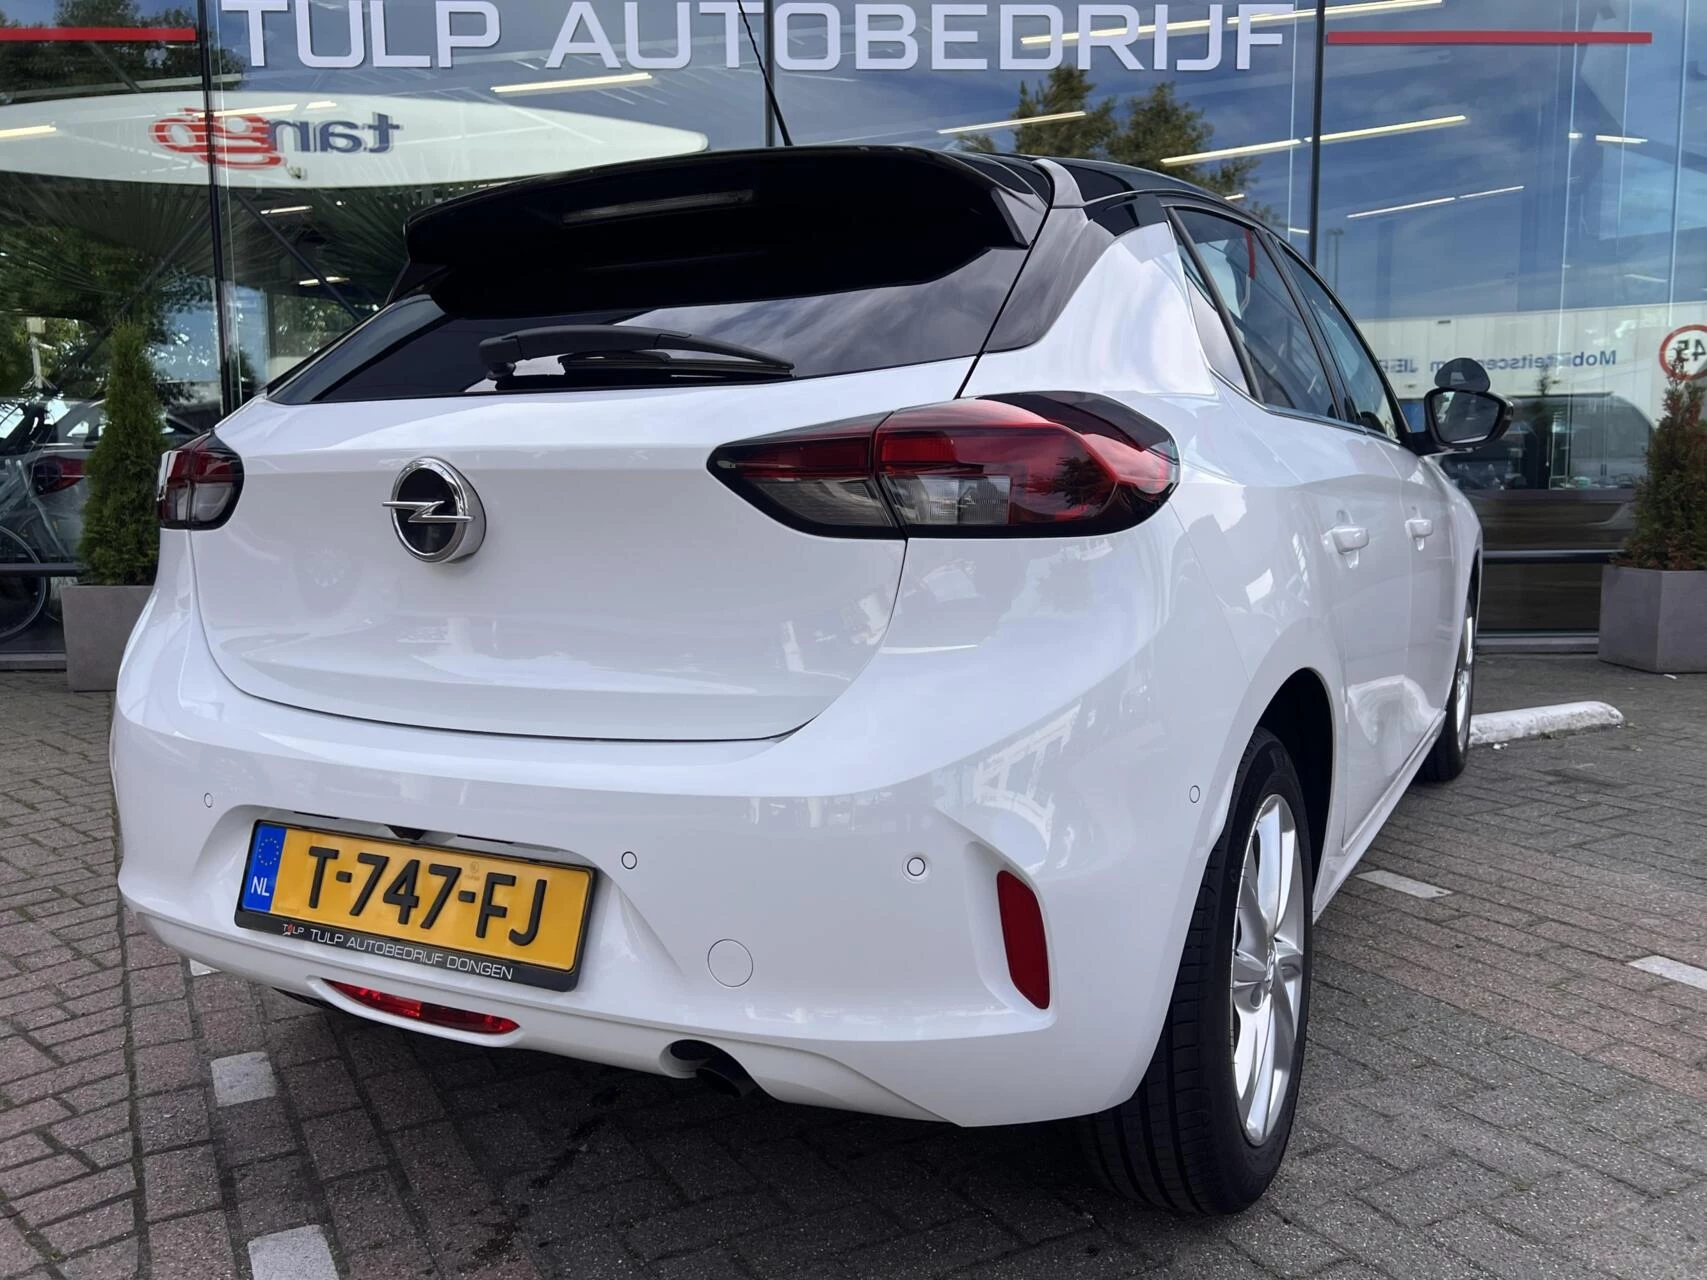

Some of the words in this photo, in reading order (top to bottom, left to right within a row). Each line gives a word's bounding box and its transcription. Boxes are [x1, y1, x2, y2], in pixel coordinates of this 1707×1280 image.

[221, 0, 501, 69] TULP
[545, 0, 1295, 72] AUTOBEDRIJF
[251, 877, 270, 897] NL
[308, 846, 548, 947] T-747-FJ
[310, 928, 344, 945] TULP
[346, 936, 443, 966] AUTOBEDRIJF
[446, 955, 514, 981] DONGEN
